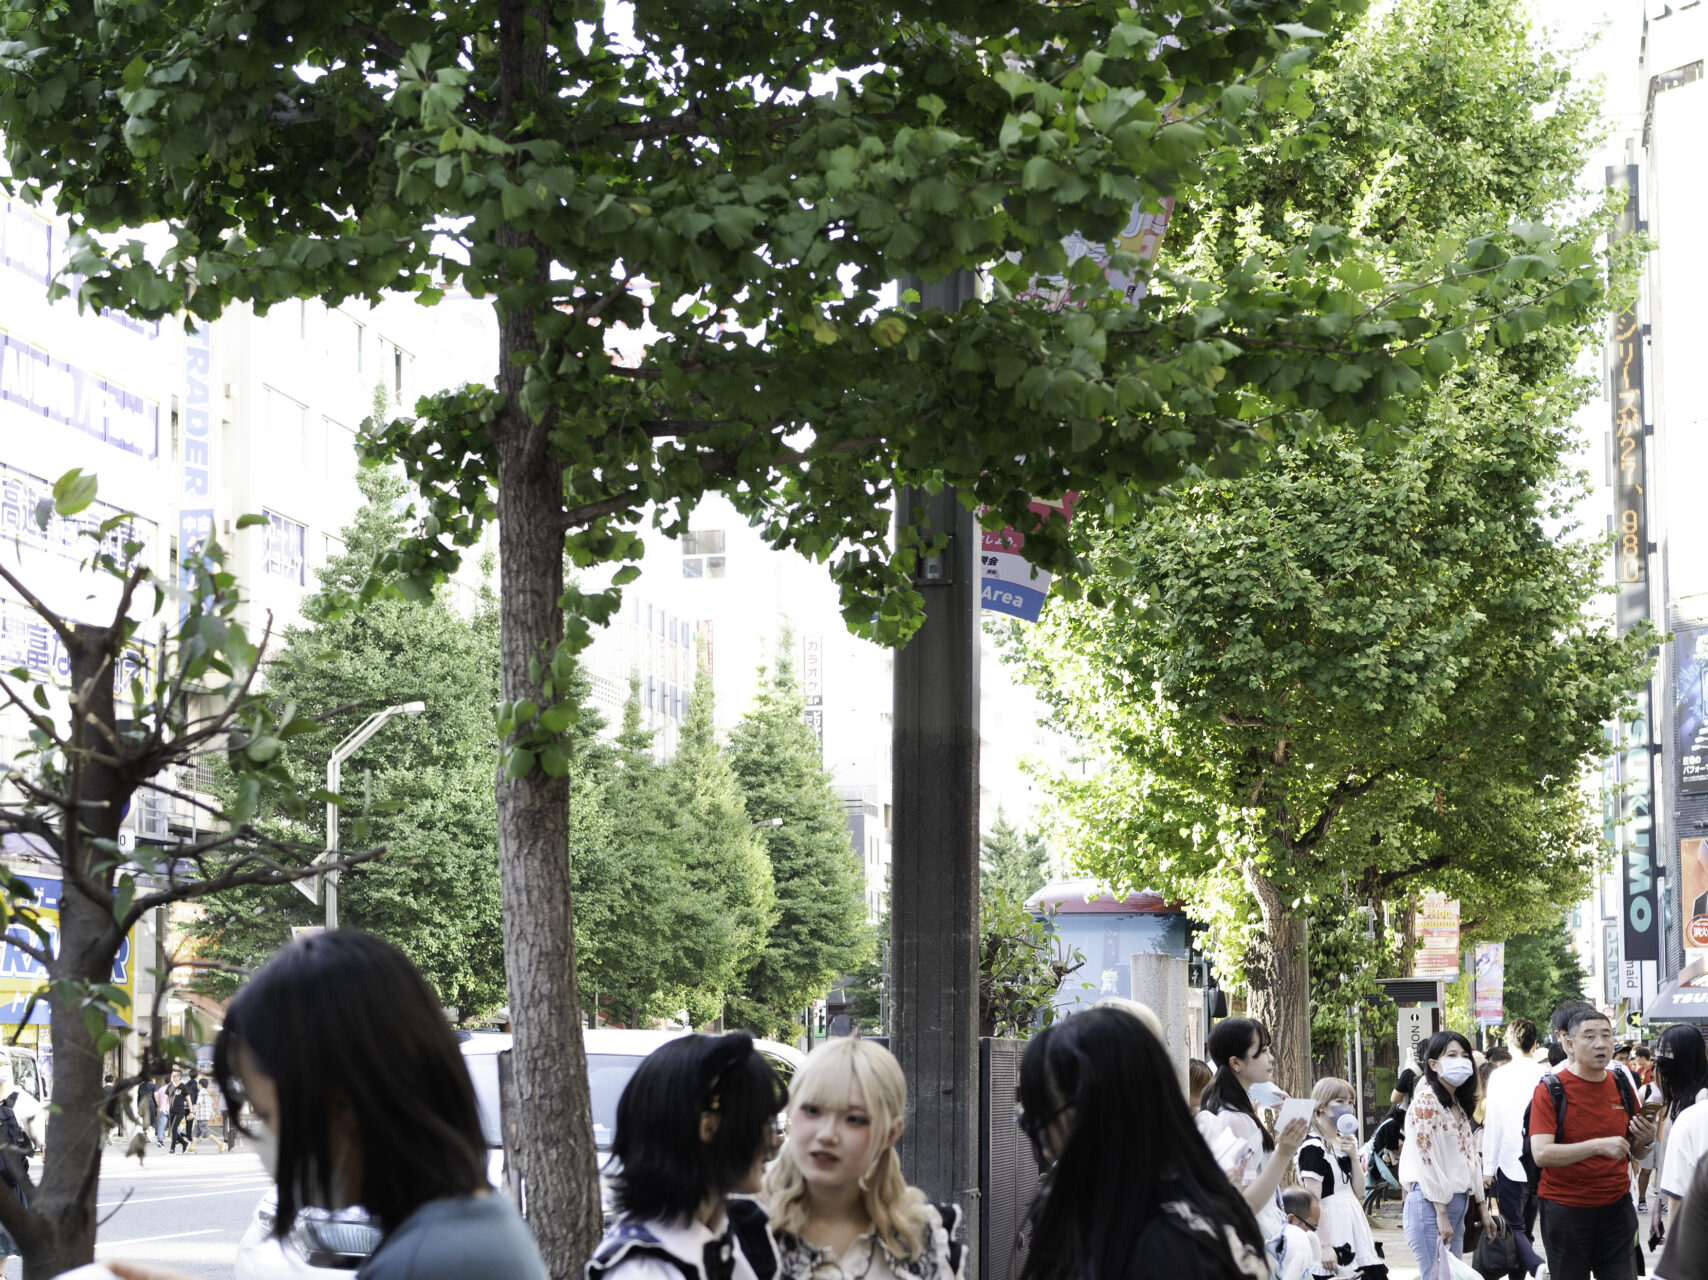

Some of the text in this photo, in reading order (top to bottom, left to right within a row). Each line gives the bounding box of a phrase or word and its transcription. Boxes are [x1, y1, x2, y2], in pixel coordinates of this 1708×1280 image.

[982, 586, 1024, 609] Area
[807, 641, 819, 691] カラオケ
[1672, 992, 1708, 1004] TSU
